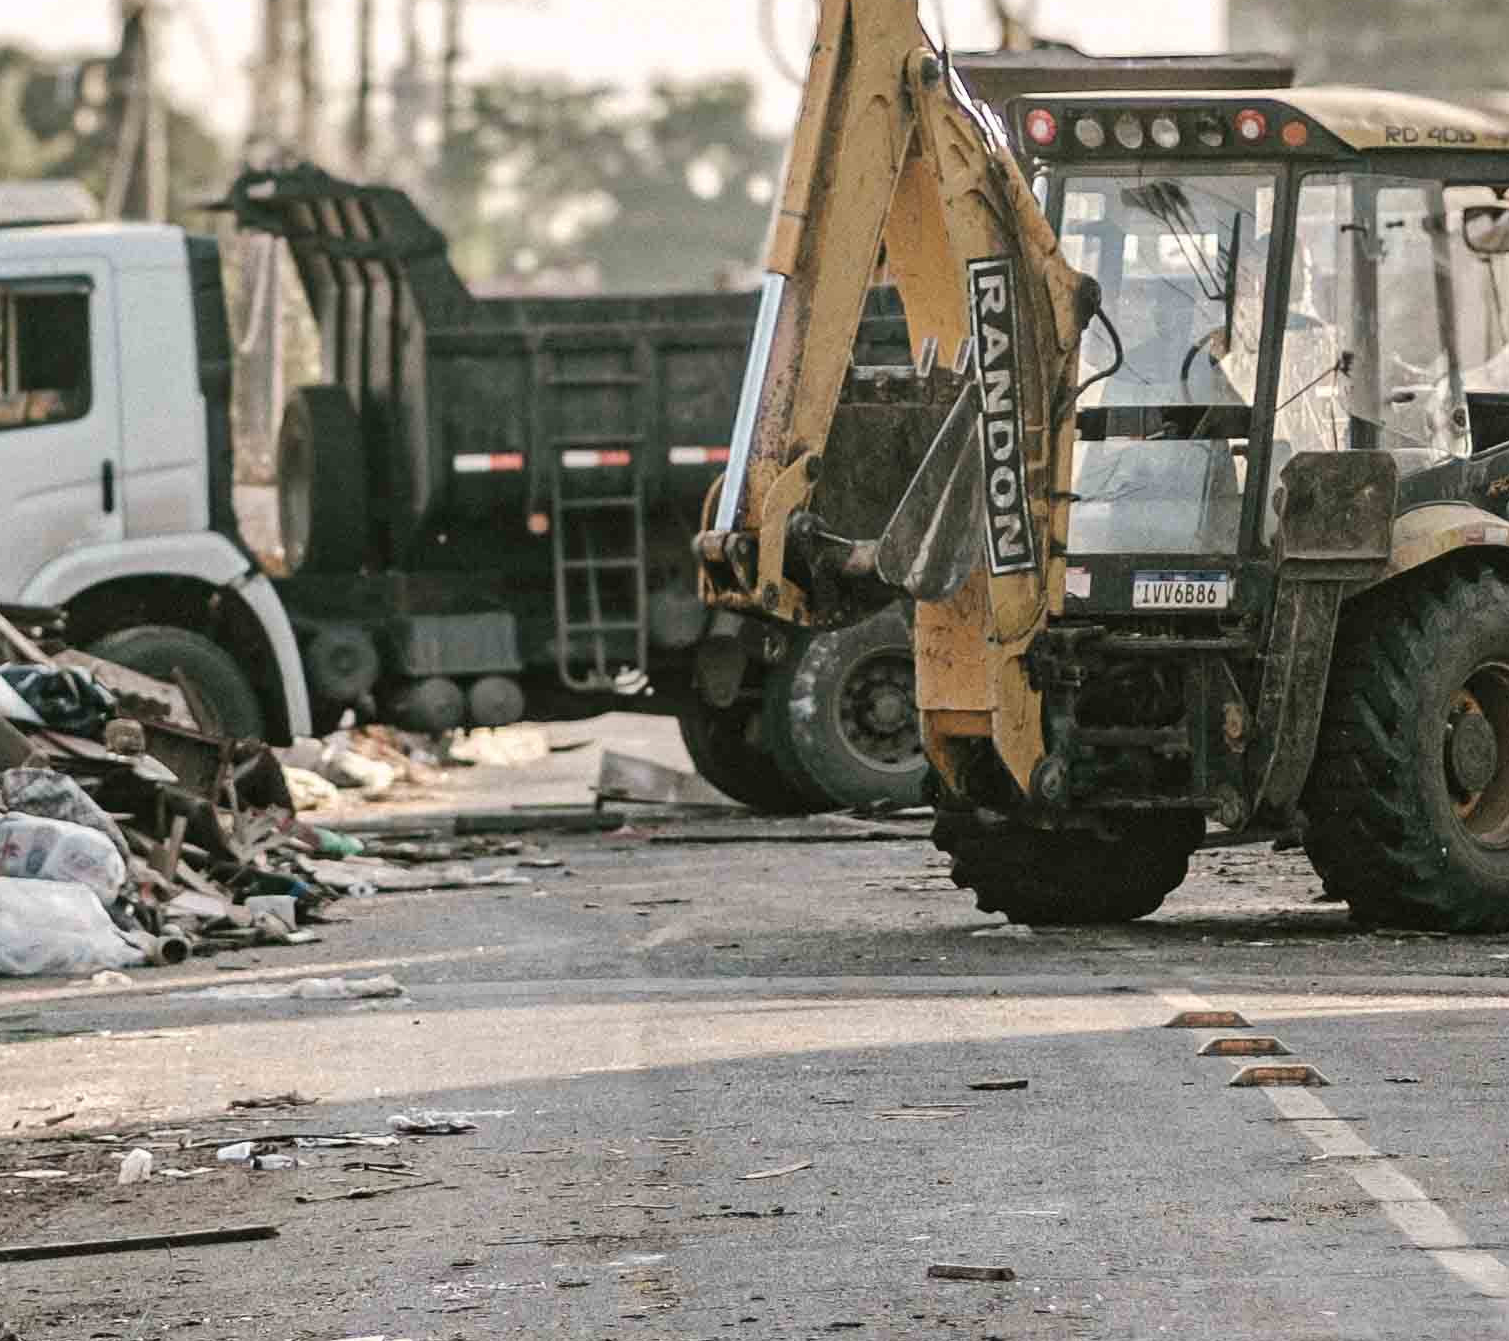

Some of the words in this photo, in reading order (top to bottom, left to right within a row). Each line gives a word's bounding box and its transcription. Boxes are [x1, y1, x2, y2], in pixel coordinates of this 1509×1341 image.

[1386, 126, 1419, 144] RD
[977, 274, 1025, 558] RANDON
[1141, 583, 1217, 604] IVV6B86
